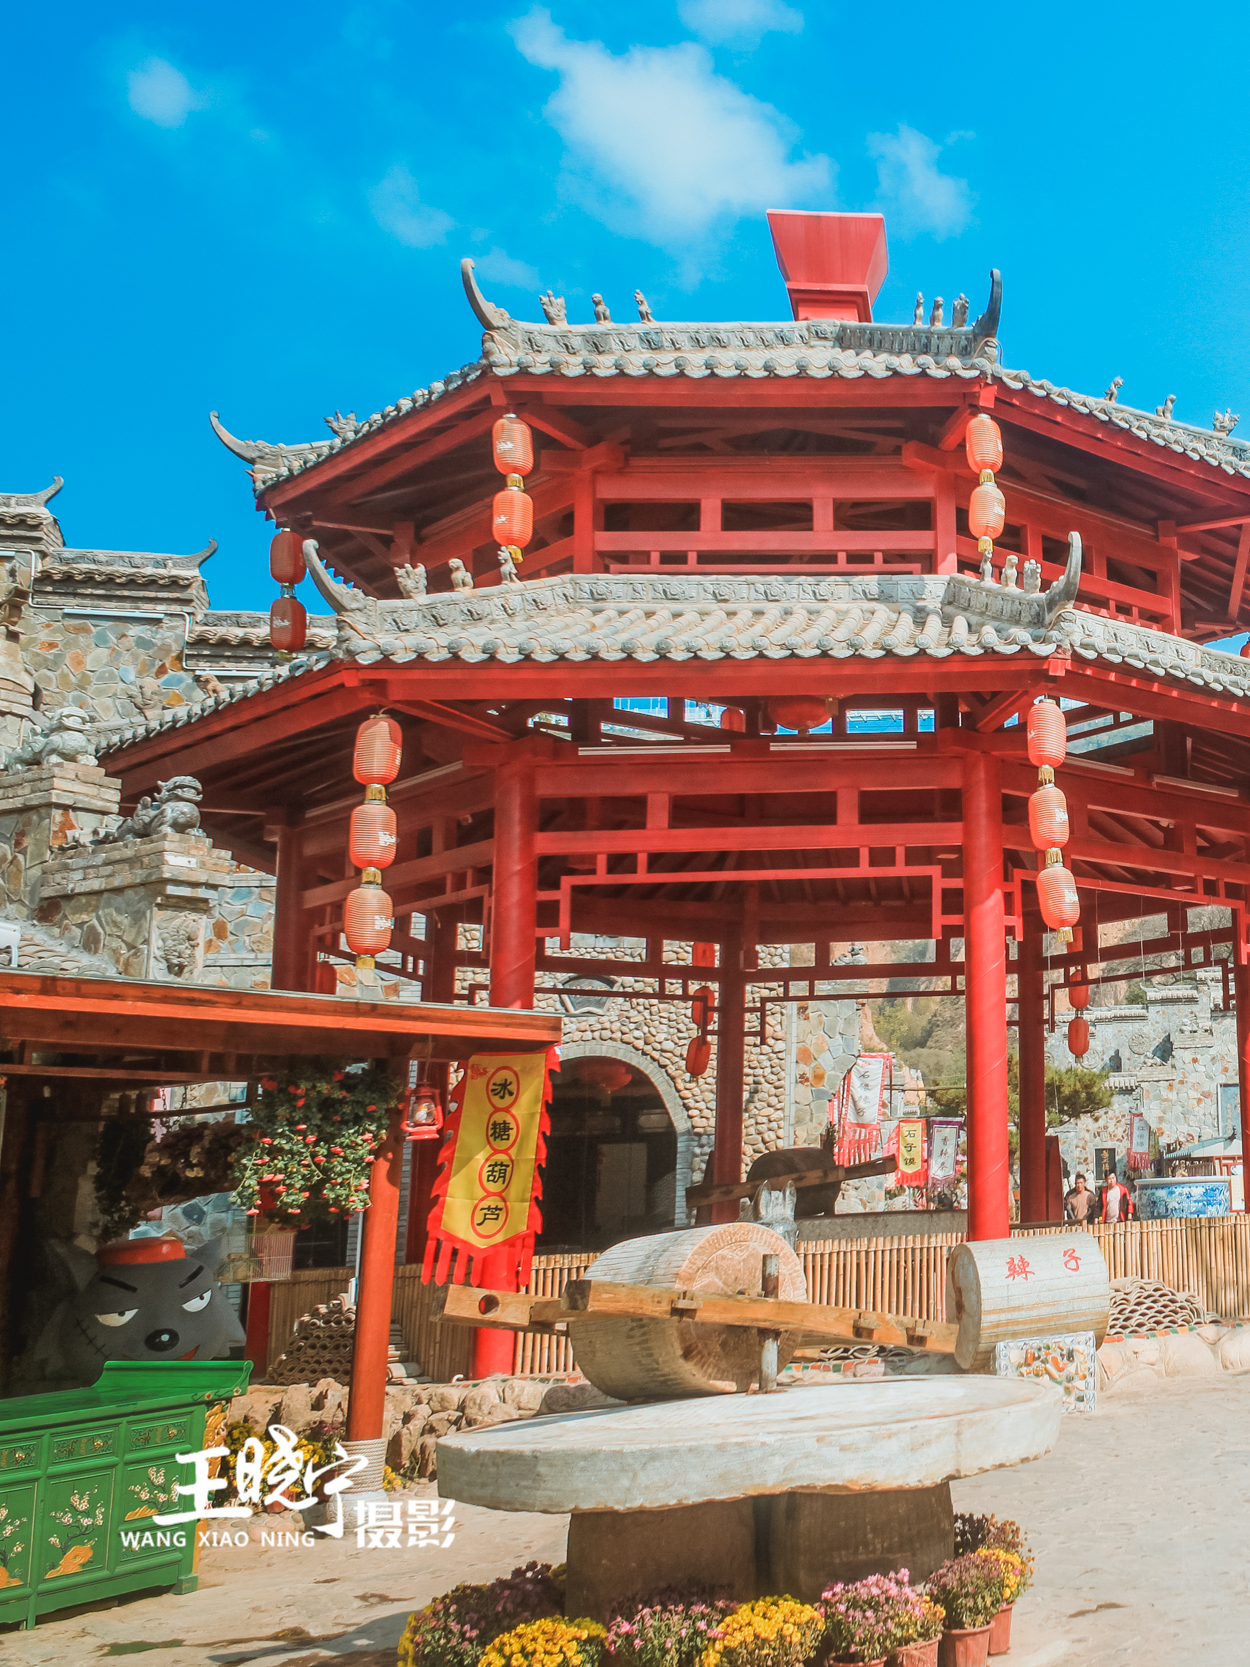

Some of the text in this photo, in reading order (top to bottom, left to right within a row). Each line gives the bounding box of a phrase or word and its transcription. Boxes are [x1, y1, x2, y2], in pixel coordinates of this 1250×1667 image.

[475, 1077, 516, 1227] 冰糖葫芦
[1004, 1247, 1083, 1282] 辣子
